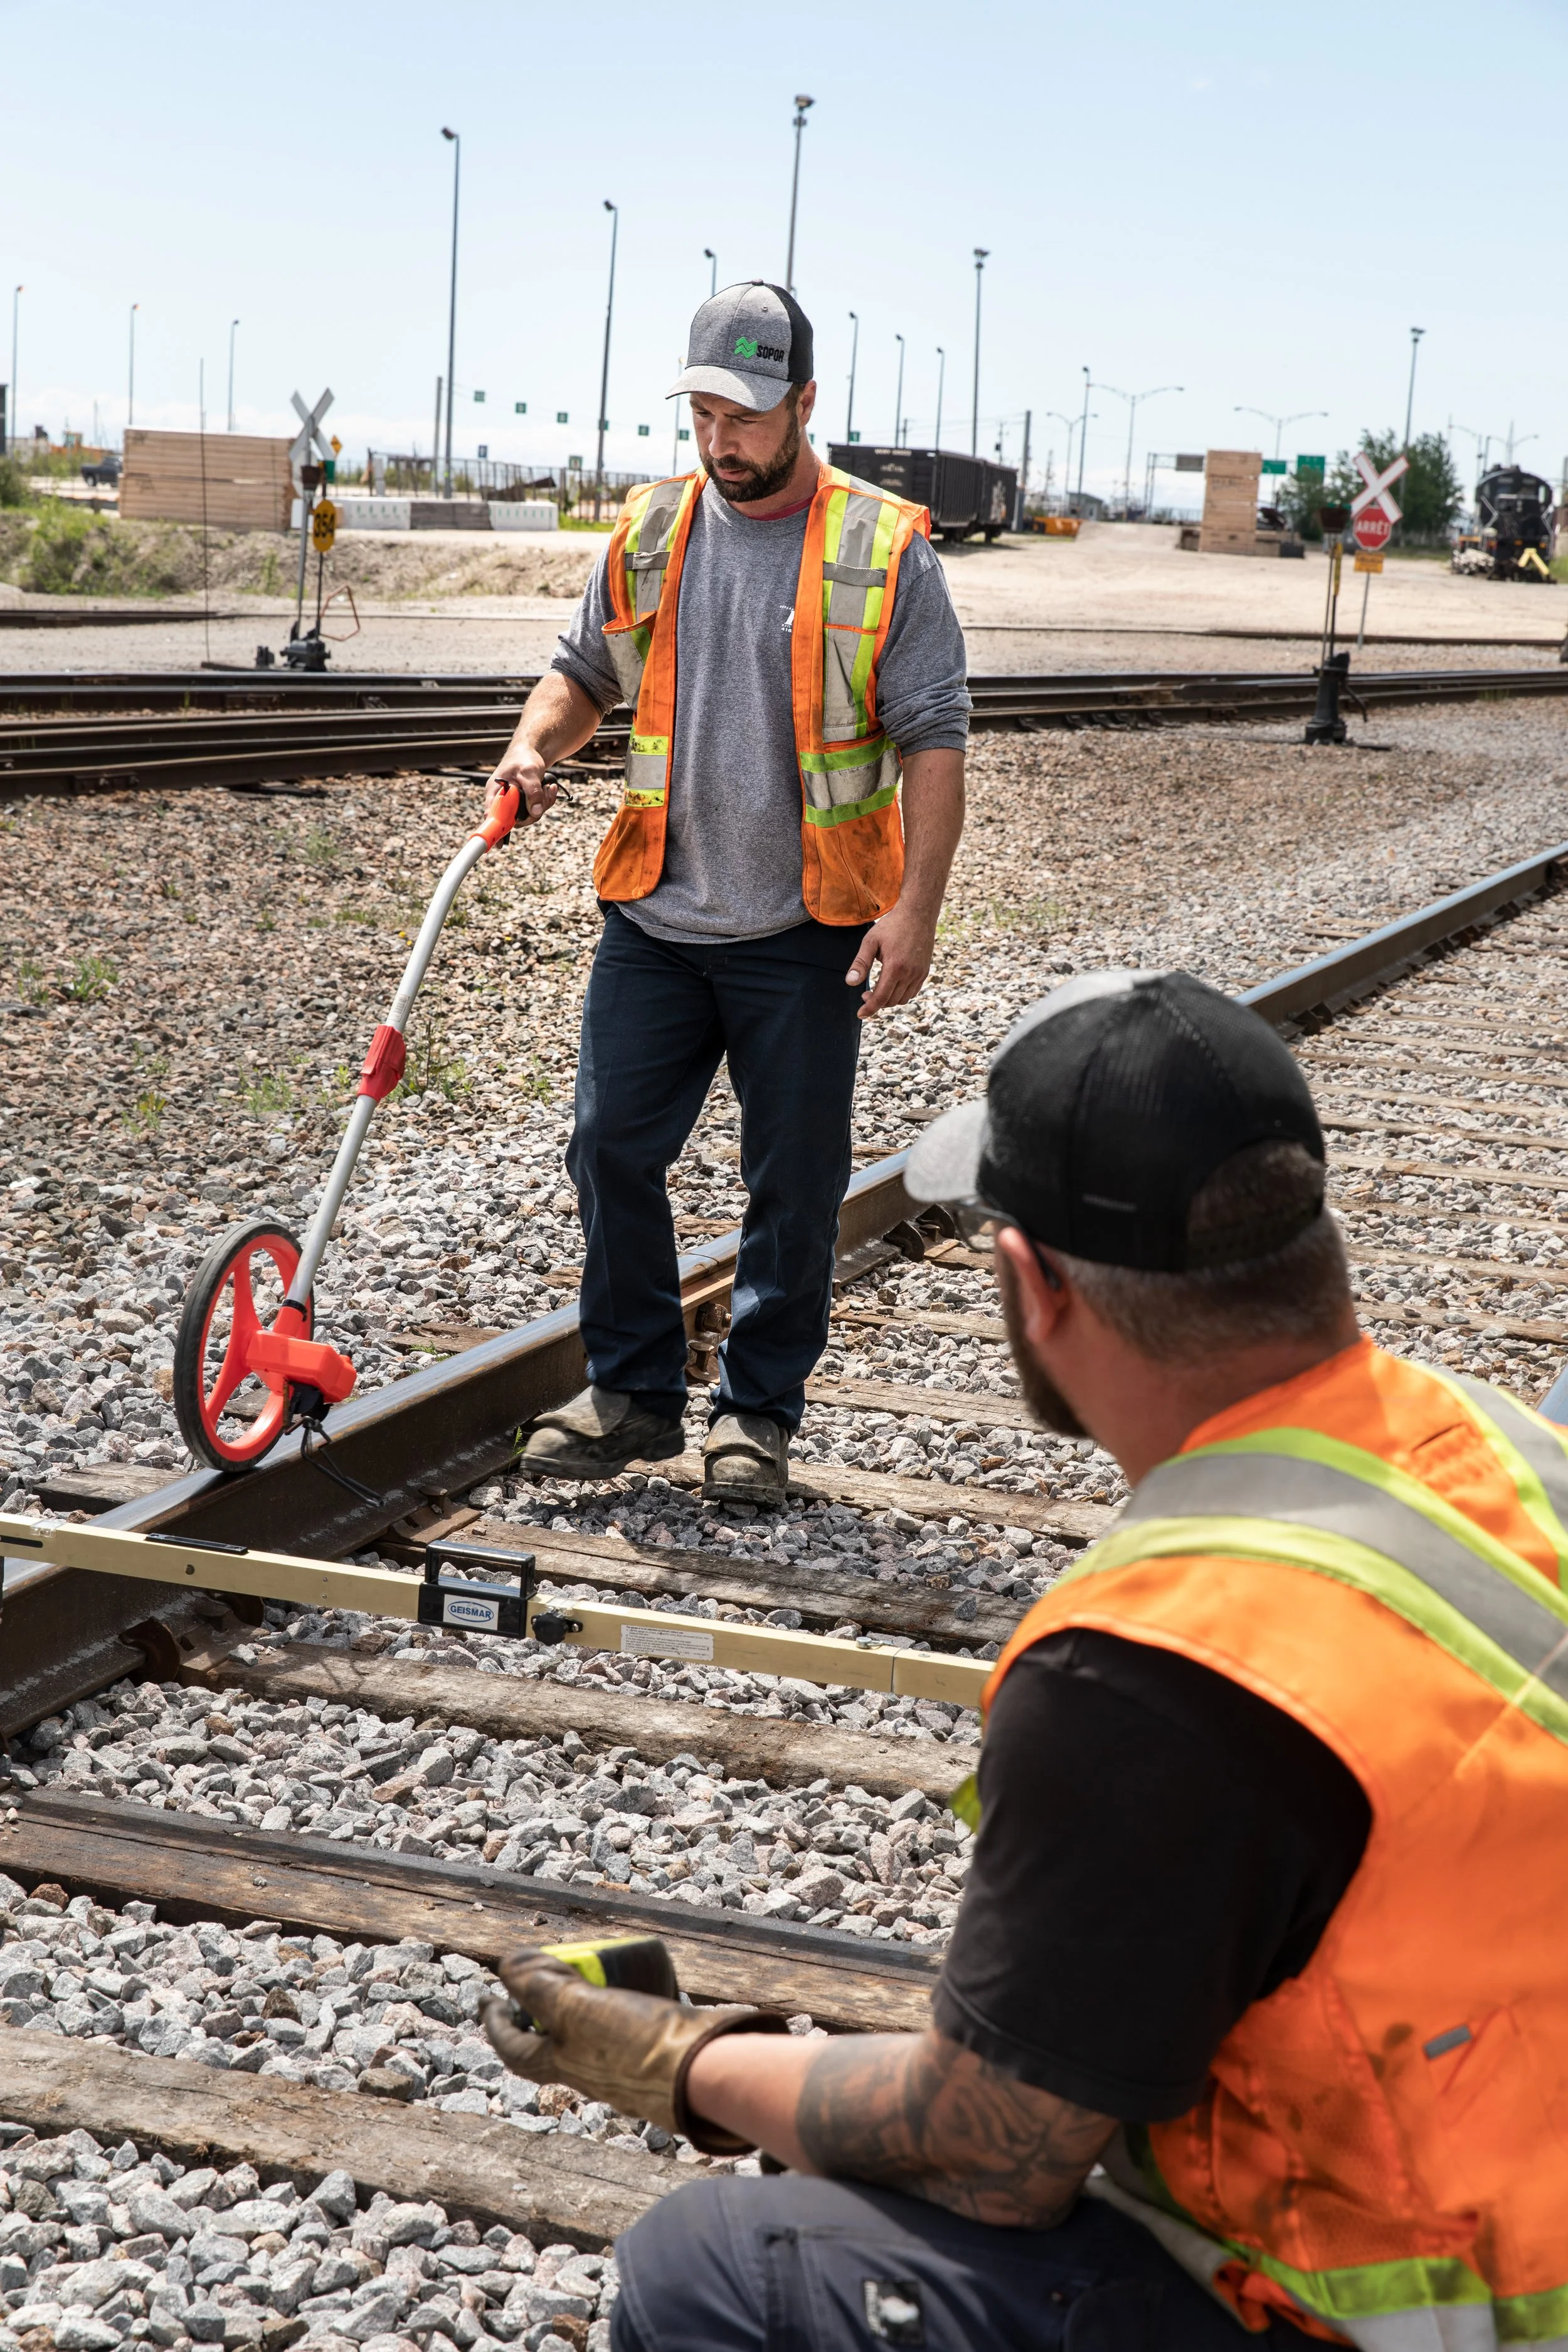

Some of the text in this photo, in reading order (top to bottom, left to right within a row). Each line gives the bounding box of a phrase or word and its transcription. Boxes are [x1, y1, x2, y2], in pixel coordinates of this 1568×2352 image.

[756, 344, 785, 363] SOPOR
[314, 513, 335, 538] 354
[1355, 519, 1389, 536] ARRÊT
[450, 1605, 492, 1620] GEISMAR
